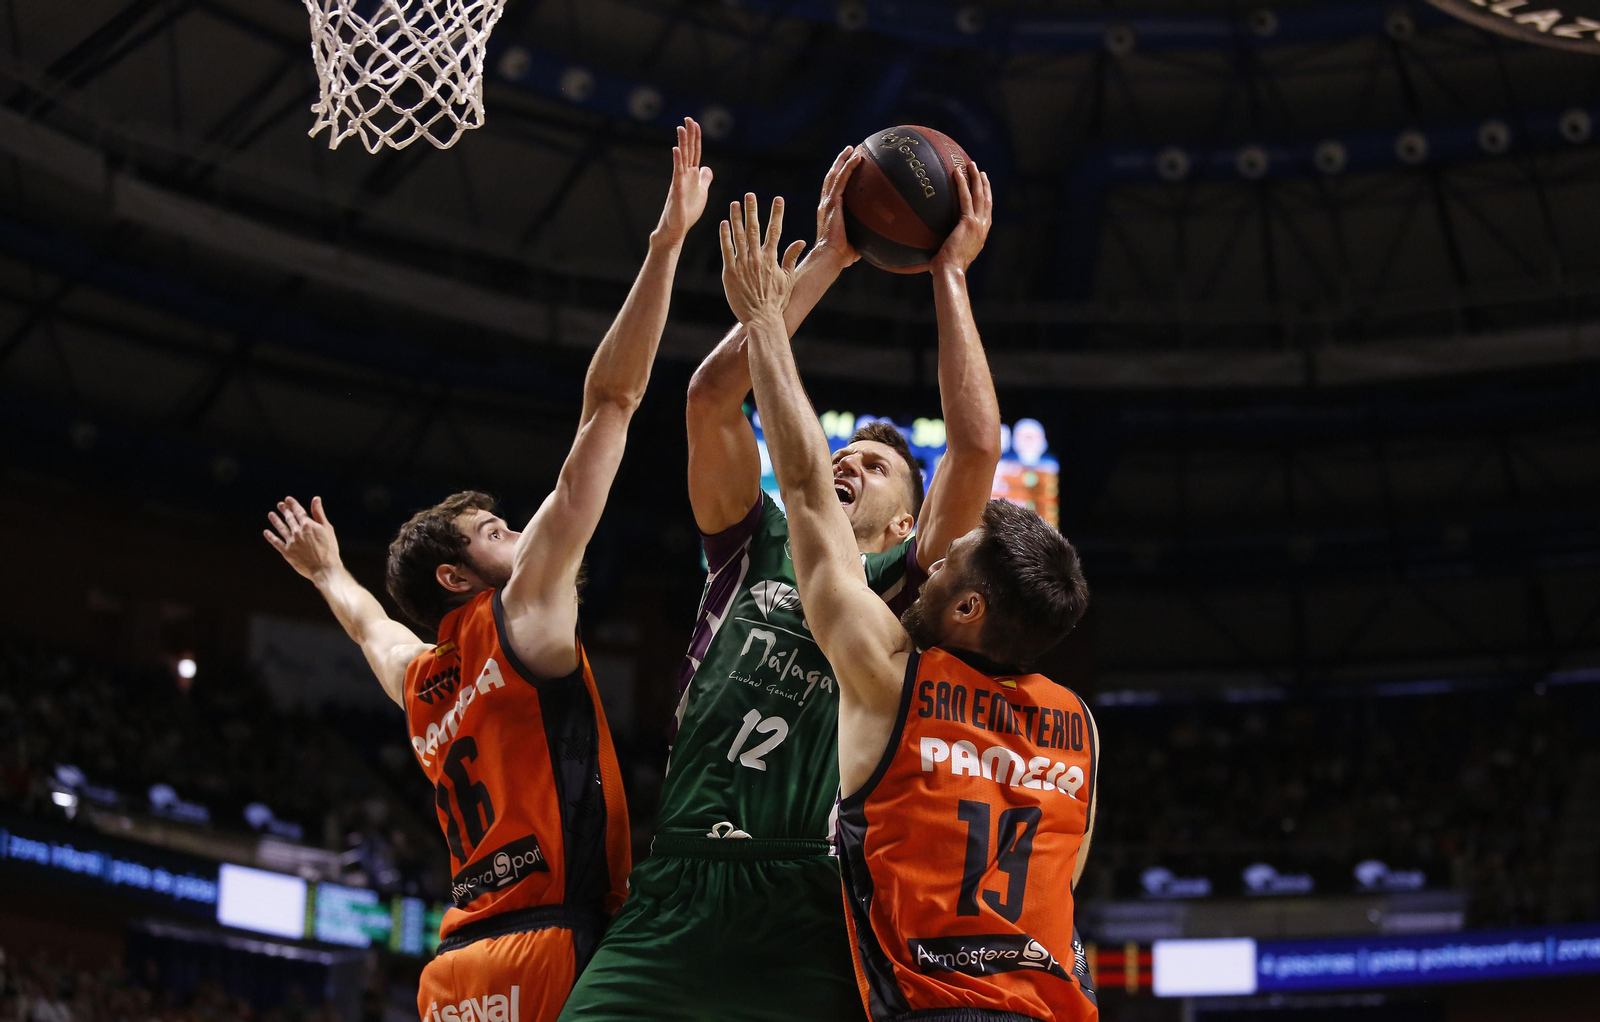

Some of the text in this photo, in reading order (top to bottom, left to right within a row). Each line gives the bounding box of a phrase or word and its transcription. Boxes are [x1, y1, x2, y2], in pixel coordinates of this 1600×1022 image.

[728, 670, 763, 688] Ciudad
[918, 680, 967, 724] SAN
[726, 708, 789, 772] 12
[956, 799, 1042, 925] 19
